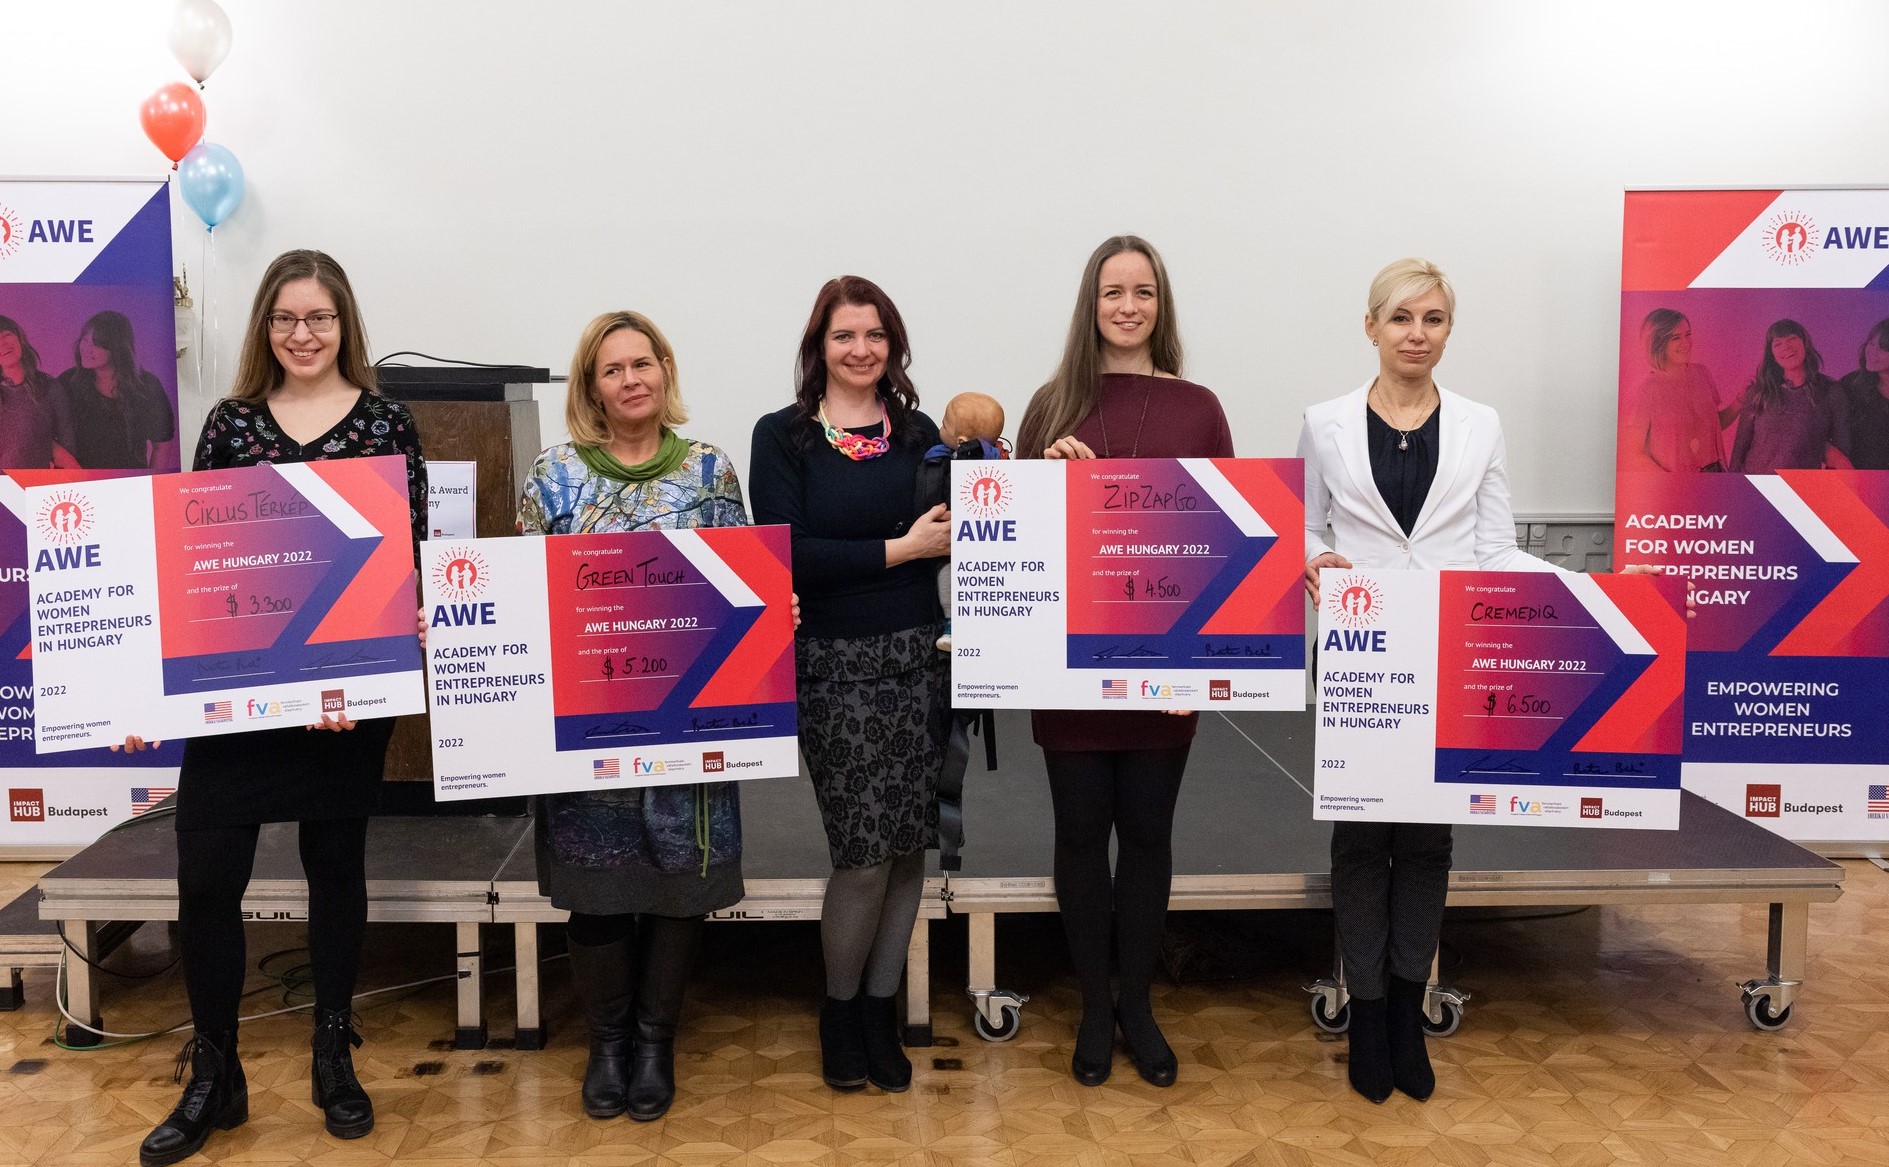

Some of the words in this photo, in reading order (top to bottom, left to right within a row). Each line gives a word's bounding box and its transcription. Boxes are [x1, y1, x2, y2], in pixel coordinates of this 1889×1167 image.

[28, 219, 94, 243] AWE
[1823, 226, 1889, 249] AWE
[1101, 473, 1139, 481] congratulate
[191, 484, 232, 494] congratulate
[429, 486, 437, 494] &
[438, 485, 468, 495] Award
[1625, 514, 1728, 530] ACADEMY
[956, 520, 1017, 541] AWE
[1102, 528, 1127, 536] winning
[195, 541, 221, 550] winning
[1099, 544, 1123, 555] AWE
[1127, 544, 1179, 555] HUNGARY
[1182, 544, 1210, 555] 2022
[1625, 539, 1668, 554] FOR
[1673, 540, 1755, 555] WOMEN
[35, 544, 101, 572] AWE
[583, 548, 623, 556] congratulate
[193, 558, 219, 571] AWE
[222, 553, 280, 568] HUNGARY
[283, 550, 312, 563] 2022
[957, 561, 1016, 571] ACADEMY
[1021, 561, 1045, 571] FOR
[1116, 569, 1132, 577] prize
[1625, 564, 1798, 580] REPRENEURS
[957, 576, 1004, 586] WOMEN
[37, 587, 102, 604] ACADEMY
[108, 584, 134, 597] FOR
[213, 584, 230, 593] prize
[1122, 576, 1134, 601] $
[1145, 576, 1181, 598] 4.500
[1476, 585, 1516, 594] congratulate
[957, 591, 1059, 601] ENTREPRENEURS
[226, 593, 238, 617] $
[250, 595, 291, 614] 3.300
[586, 605, 612, 613] winning
[957, 606, 970, 616] IN
[974, 606, 1033, 616] HUNGARY
[37, 605, 90, 620] WOMEN
[431, 602, 496, 627] AWE
[38, 614, 152, 636] ENTREPRENEURS
[584, 621, 609, 633] AWE
[612, 619, 667, 631] HUNGARY
[670, 617, 698, 628] 2022
[39, 641, 53, 652] IN
[57, 633, 123, 651] HUNGARY
[1324, 629, 1386, 652] AWE
[1475, 642, 1501, 650] winning
[433, 645, 497, 659] ACADEMY
[502, 643, 528, 655] FOR
[603, 647, 619, 655] prize
[957, 648, 981, 657] 2022
[434, 661, 485, 674] WOMEN
[602, 655, 614, 682] $
[622, 657, 667, 674] 5.200
[1471, 658, 1497, 669] AWE
[1500, 659, 1556, 671] HUNGARY
[1558, 660, 1586, 671] 2022
[435, 673, 545, 690] ENTREPRENEURS
[1323, 671, 1385, 683] ACADEMY
[1390, 673, 1415, 684] FOR
[40, 685, 67, 697] 2022
[957, 683, 995, 691] Empowering
[1141, 680, 1172, 697] fva
[1323, 686, 1373, 698] WOMEN
[1489, 684, 1505, 692] prize
[1707, 682, 1840, 697] EMPOWERING
[436, 695, 450, 706] IN
[454, 690, 517, 705] HUNGARY
[1211, 690, 1228, 698] HUB
[1232, 691, 1270, 699] Budapest
[247, 699, 280, 716] fva
[347, 697, 387, 707] Budapest
[1323, 701, 1429, 715] ENTREPRENEURS
[1483, 692, 1496, 717] $
[1734, 702, 1810, 716] WOMEN
[41, 723, 85, 733] Empowering
[1323, 716, 1336, 727] IN
[1340, 717, 1401, 729] HUNGARY
[1691, 722, 1852, 737] ENTREPRENEURS
[42, 731, 92, 742] entrepreneurs.
[438, 738, 464, 748] 2022
[633, 757, 665, 773] fva
[726, 760, 763, 768] Budapest
[1321, 759, 1346, 769] 2022
[440, 773, 481, 782] Empowering
[441, 782, 488, 790] entrepreneurs.
[1320, 794, 1359, 803] Empowering
[1510, 796, 1541, 813] fva
[14, 806, 41, 816] HUB
[48, 806, 108, 818] Budapest
[1319, 803, 1365, 811] entrepreneurs.
[1749, 802, 1777, 812] HUB
[1784, 802, 1843, 815] Budapest
[1604, 809, 1642, 818] Budapest
[704, 911, 764, 919] UIL
